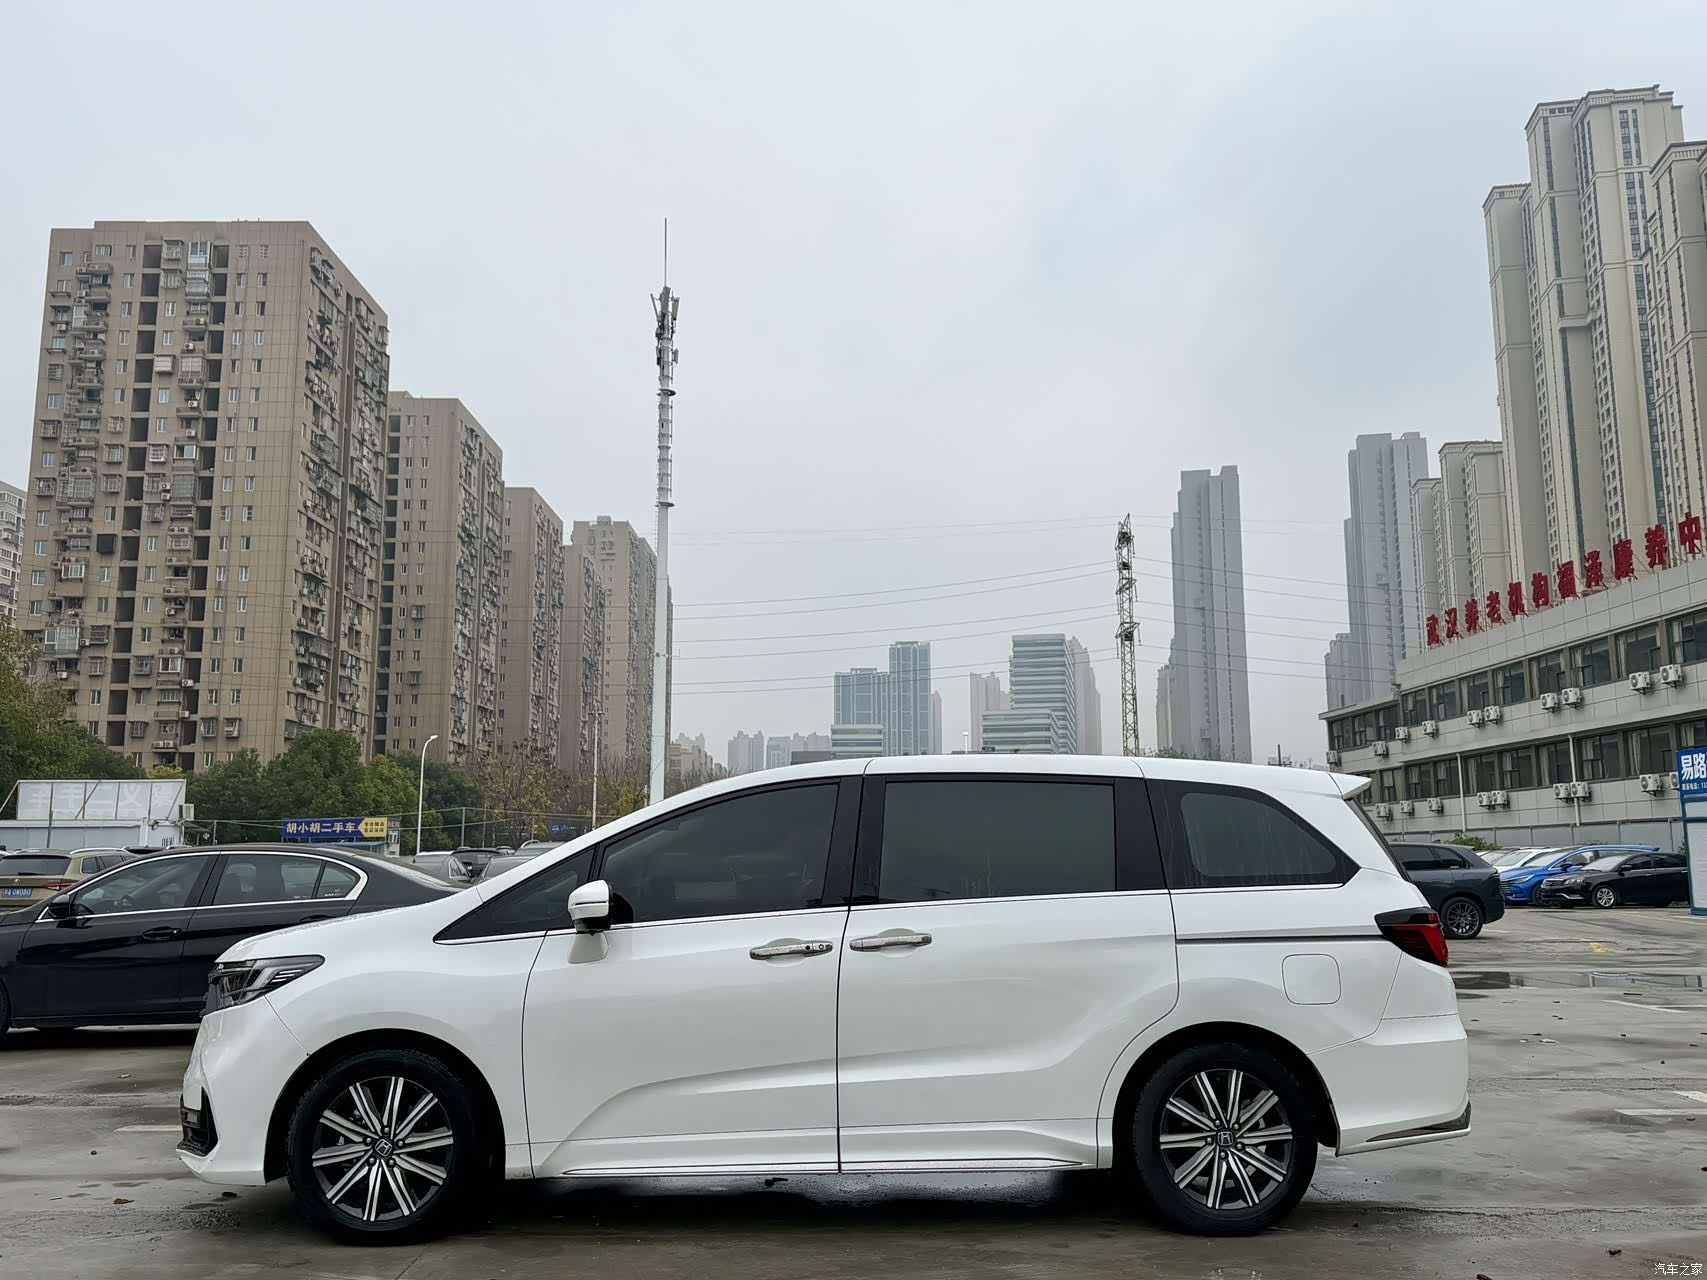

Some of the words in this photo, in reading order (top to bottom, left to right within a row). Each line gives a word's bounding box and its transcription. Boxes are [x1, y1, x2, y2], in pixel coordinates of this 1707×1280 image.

[1680, 752, 1707, 780] 易路
[286, 822, 356, 833] 胡小胡二手车
